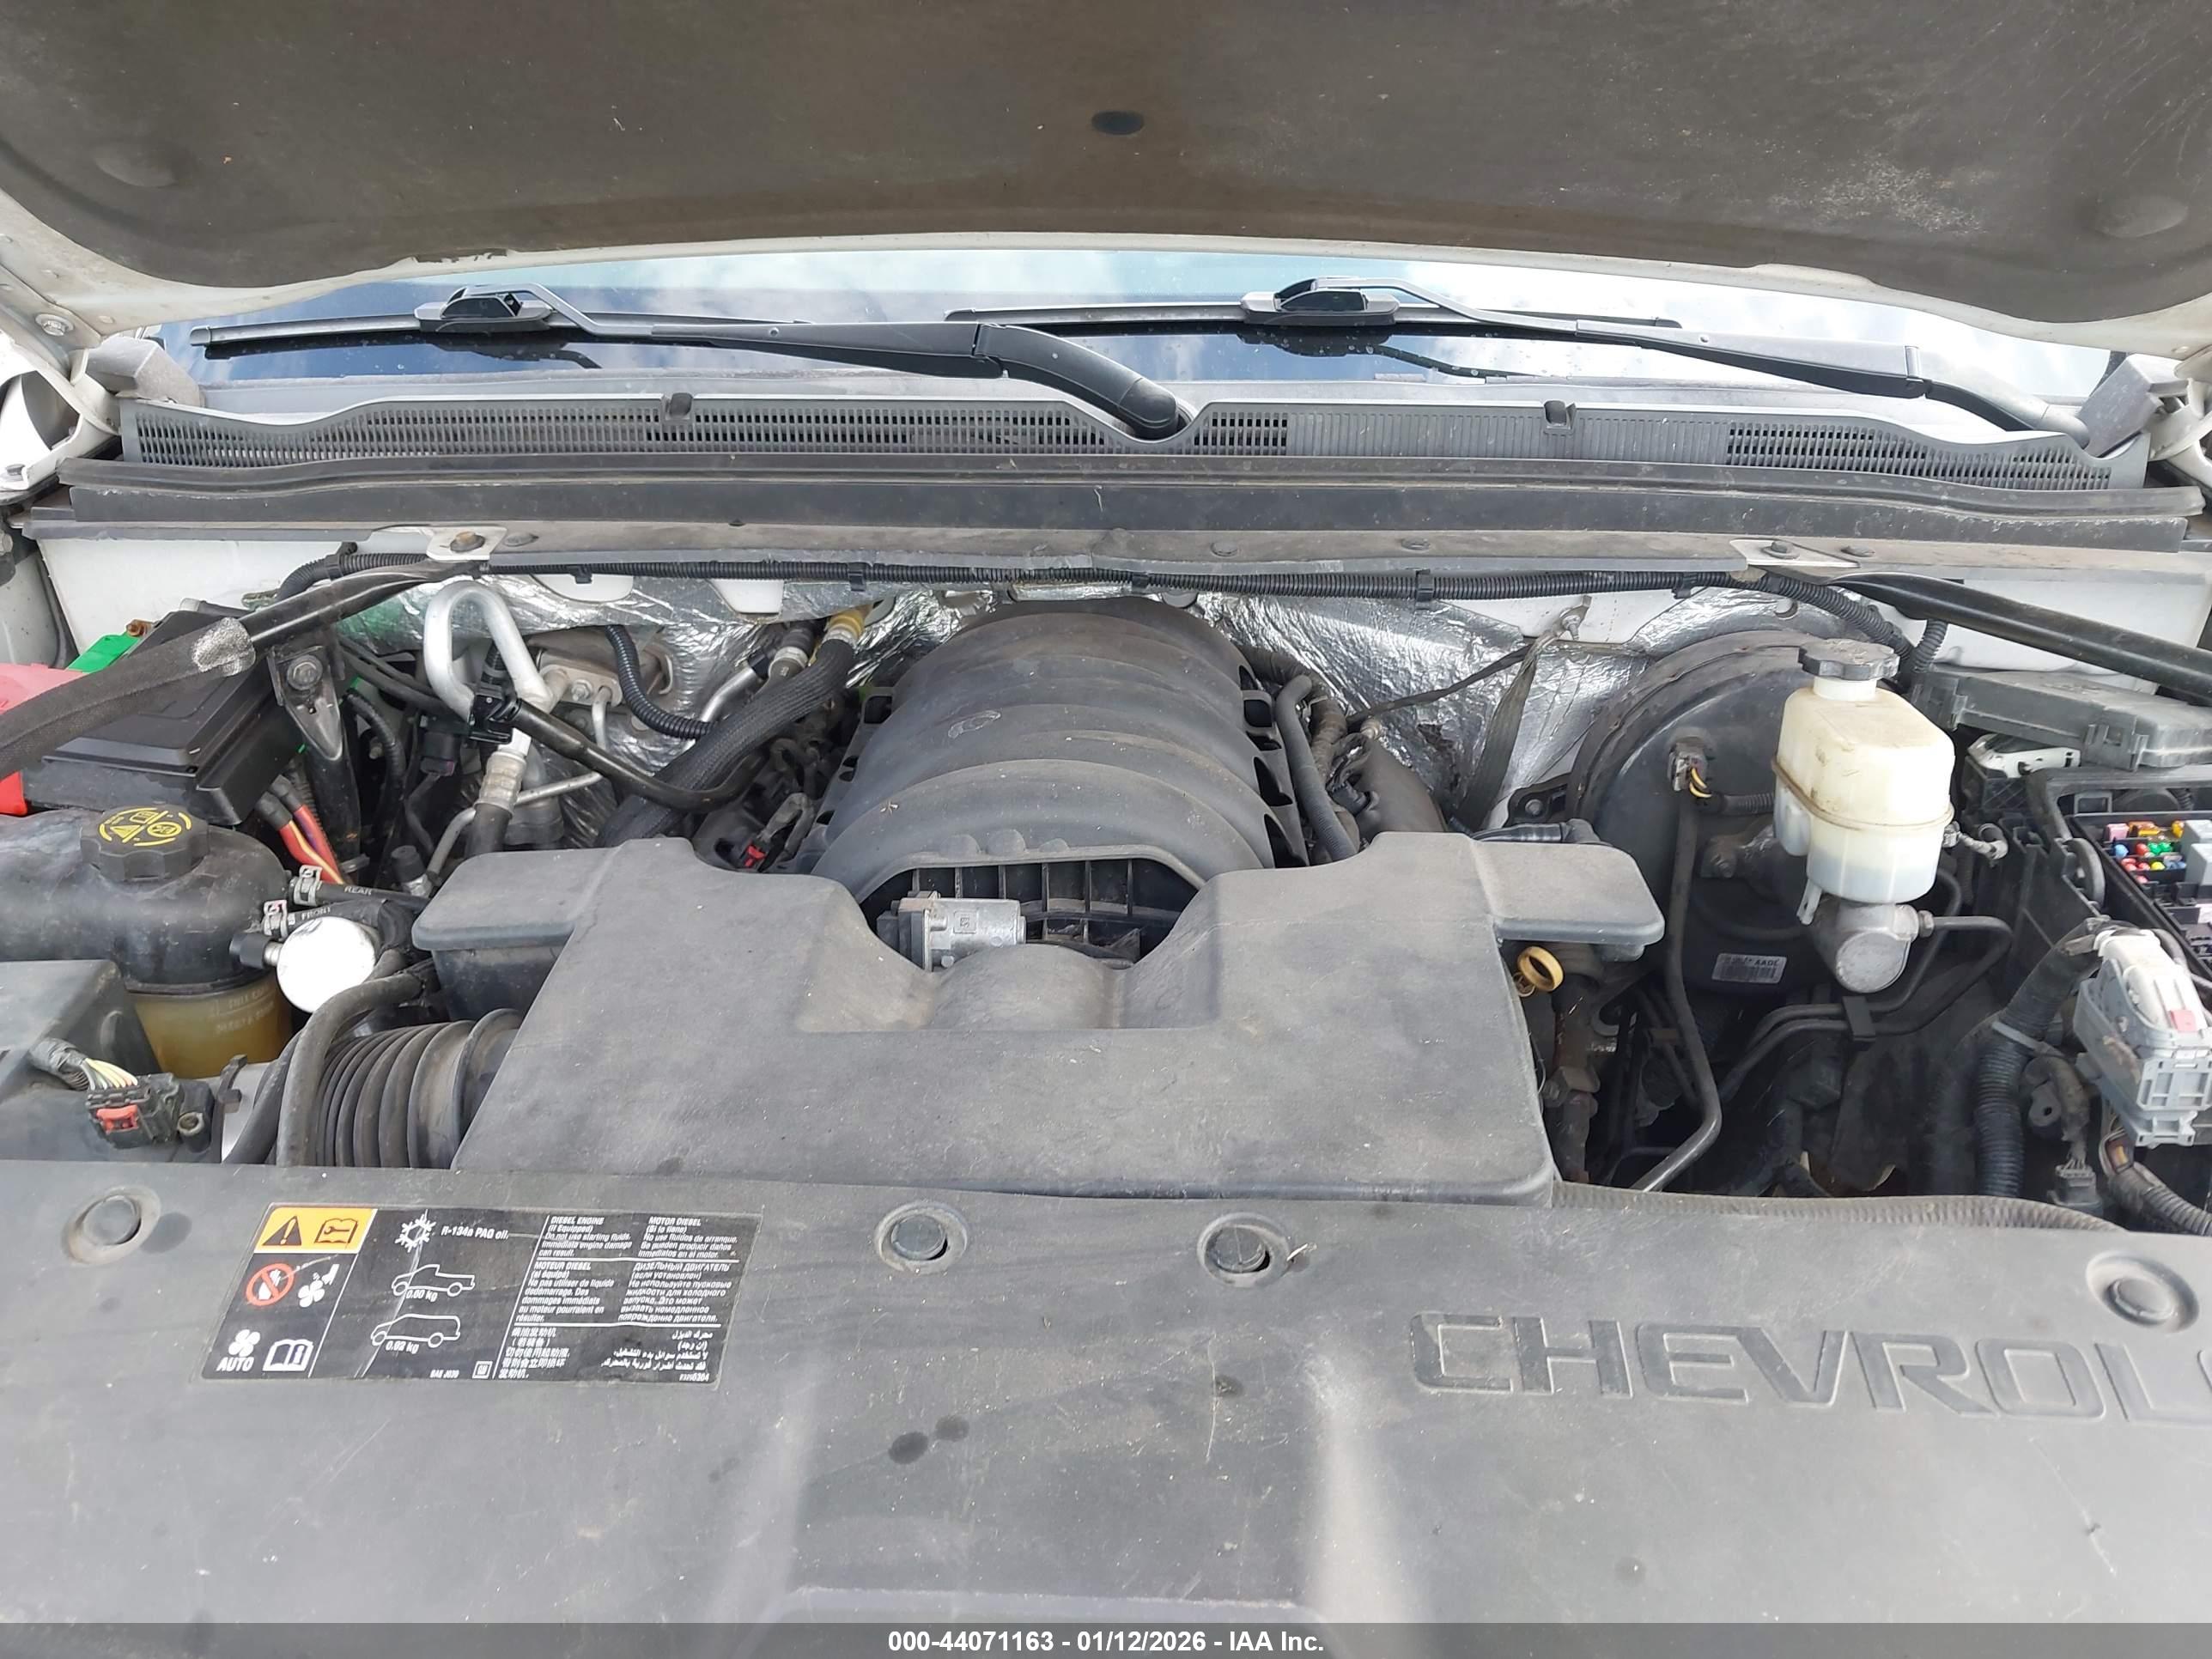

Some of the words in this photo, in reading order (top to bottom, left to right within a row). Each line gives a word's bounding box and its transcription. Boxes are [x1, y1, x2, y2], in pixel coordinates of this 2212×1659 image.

[344, 885, 372, 896] REAR
[301, 907, 331, 921] FRONT
[550, 1216, 576, 1224] DIESEL
[576, 1217, 605, 1225] ENGINE
[648, 1217, 676, 1225] MOTOR
[676, 1218, 702, 1226] DIESEL
[441, 1225, 474, 1237] R-134a
[533, 1261, 566, 1270] MOTEUR
[565, 1261, 592, 1271] DIESEL
[216, 1357, 254, 1372] AUTO
[1409, 1310, 2212, 1426] CHEVROL
